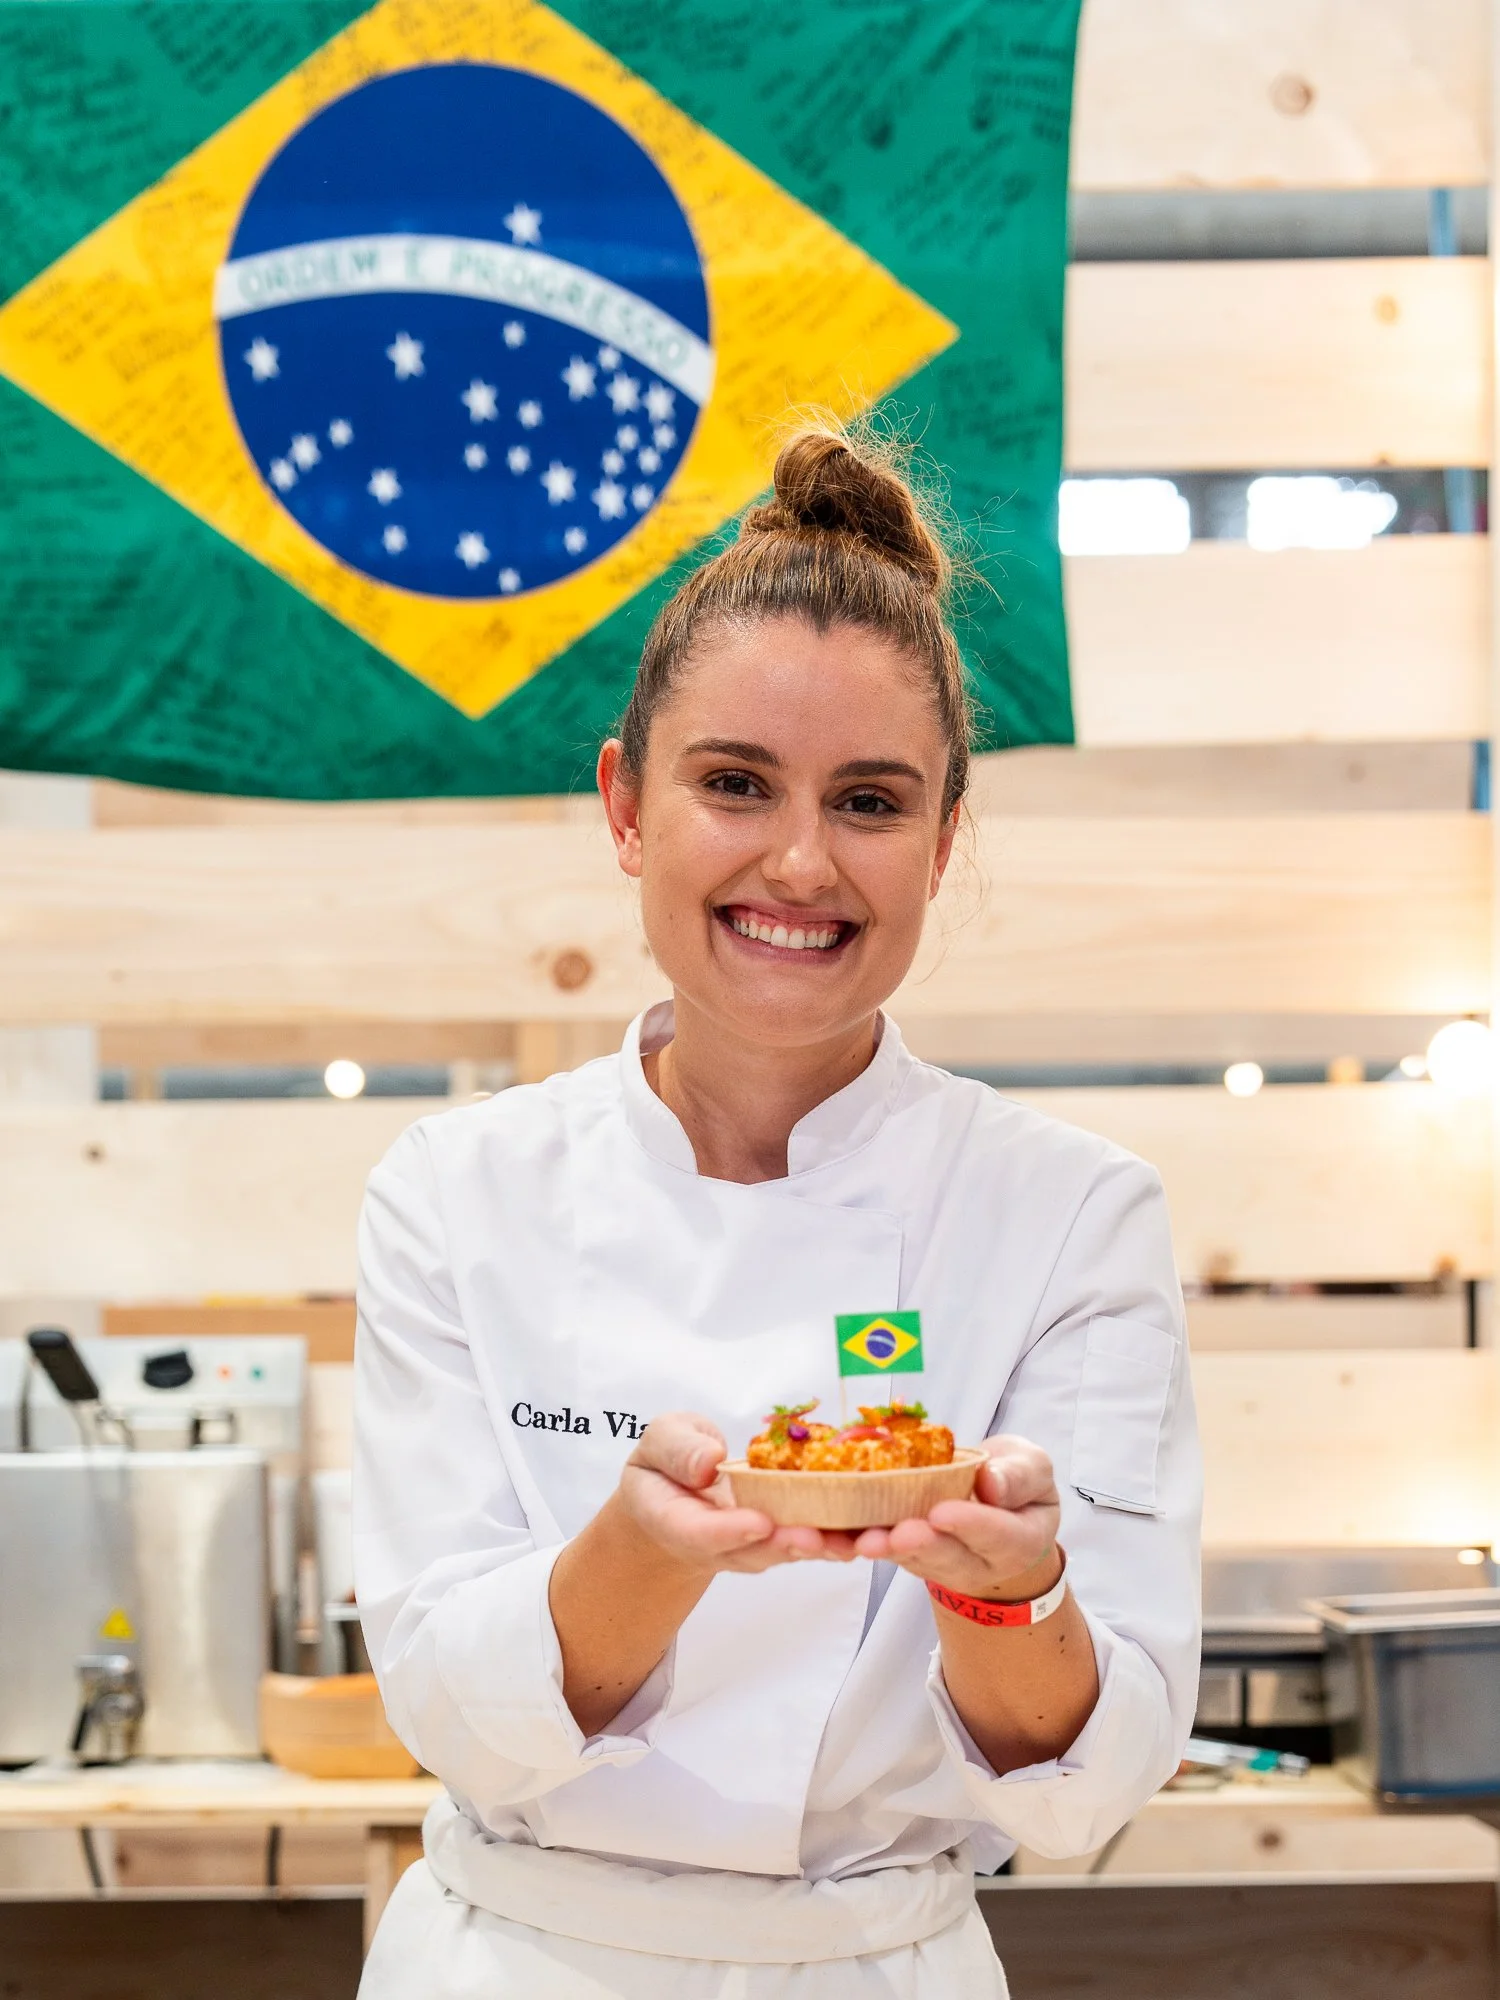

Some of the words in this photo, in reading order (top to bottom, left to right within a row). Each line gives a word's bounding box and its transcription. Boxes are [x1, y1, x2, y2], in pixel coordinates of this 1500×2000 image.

[238, 246, 380, 303] ORDEM
[404, 244, 421, 285] E
[450, 246, 690, 370] PROGRESSO
[511, 1402, 592, 1435] Carla
